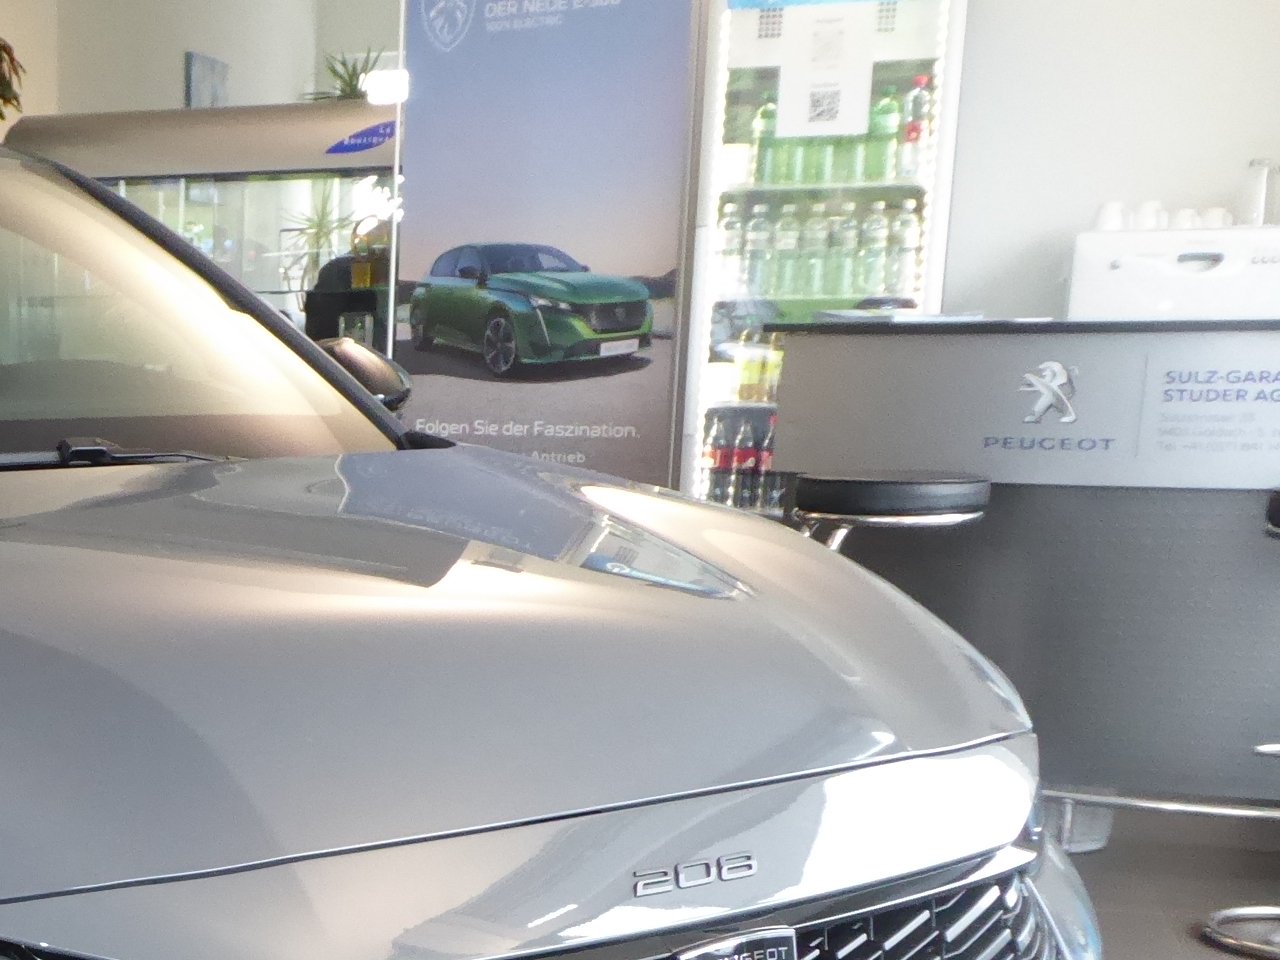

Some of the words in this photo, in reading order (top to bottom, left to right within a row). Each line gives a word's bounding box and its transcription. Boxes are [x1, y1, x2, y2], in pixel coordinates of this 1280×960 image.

[1163, 388, 1248, 402] STUDER
[1255, 388, 1280, 402] AG
[415, 418, 469, 437] Folgen
[474, 420, 499, 435] Sie
[502, 420, 529, 435] der
[533, 421, 641, 438] Faszination.
[983, 436, 1116, 451] PEUGEOT
[633, 850, 758, 897] 208
